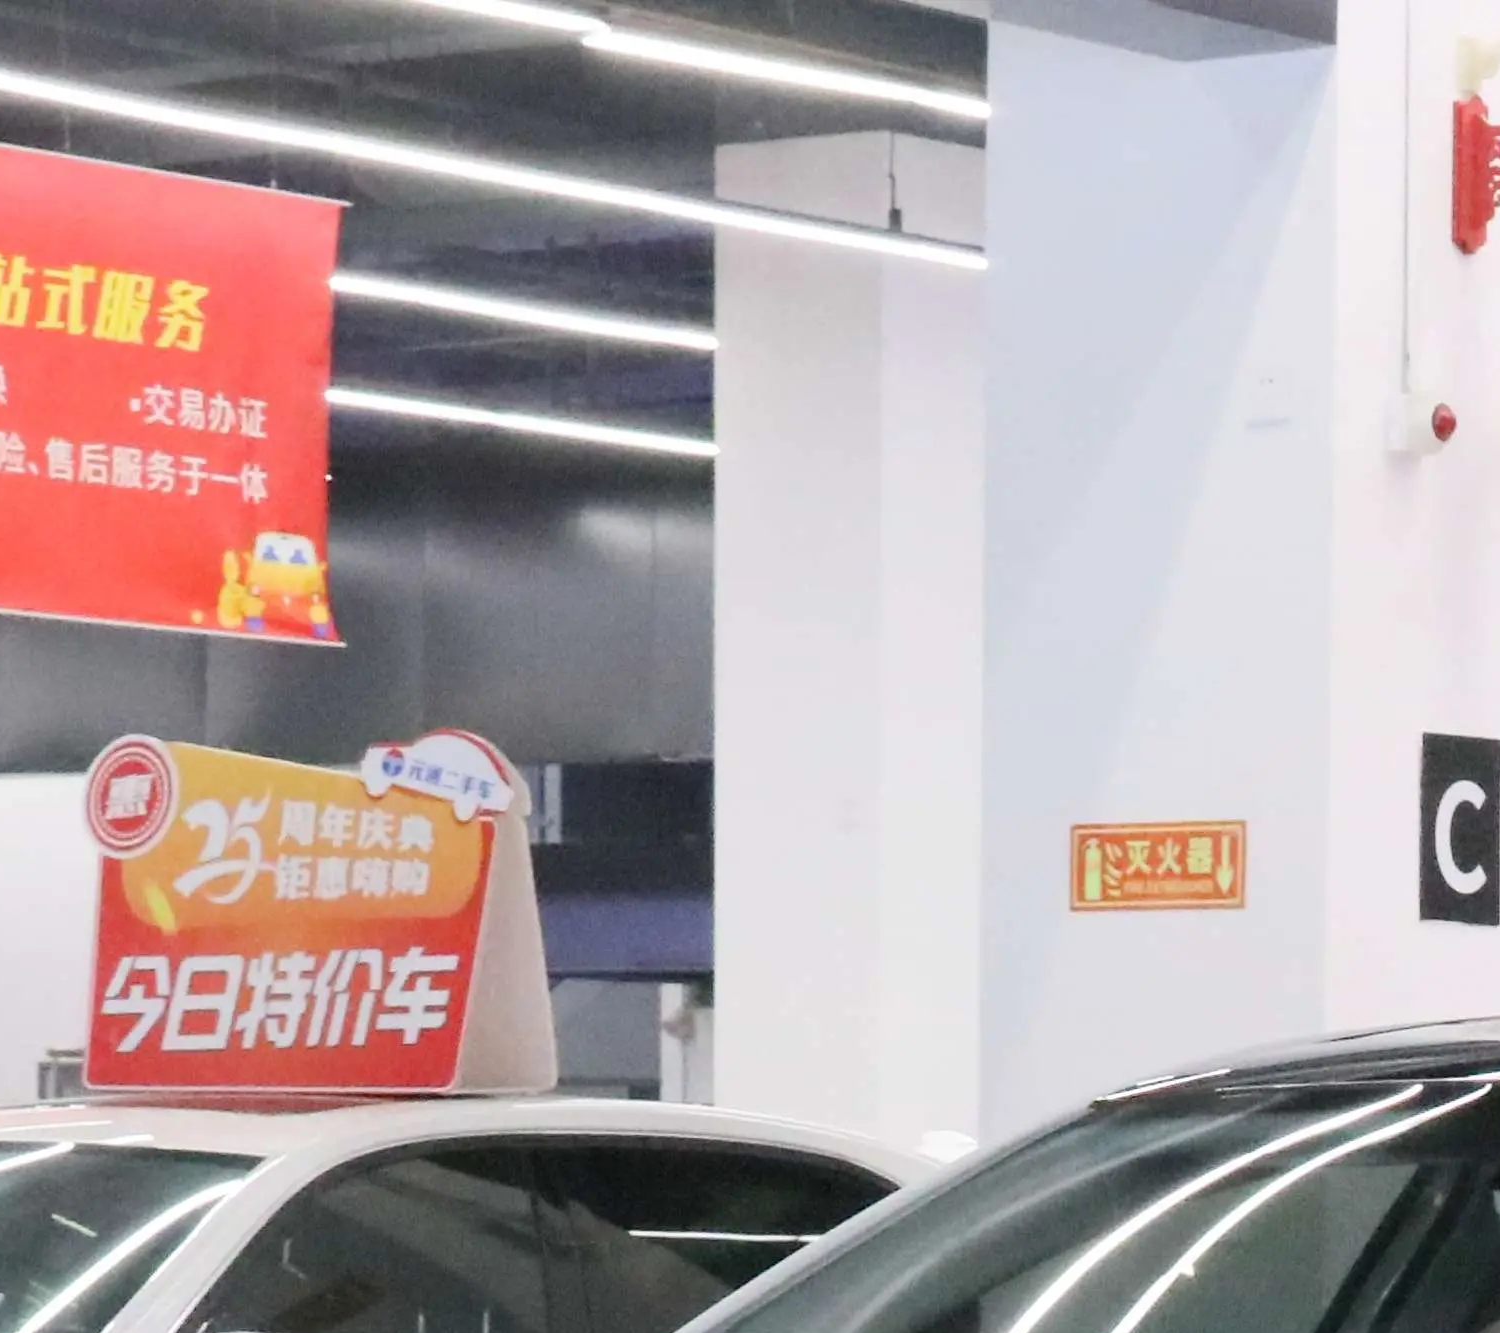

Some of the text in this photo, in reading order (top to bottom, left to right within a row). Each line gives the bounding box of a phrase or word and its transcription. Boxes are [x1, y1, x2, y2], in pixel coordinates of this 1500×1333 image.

[144, 384, 268, 439] 交易办证
[173, 786, 274, 904] 25
[278, 799, 434, 853] 周年庆典
[1126, 836, 1214, 876] 灭火器
[1435, 780, 1487, 894] C
[102, 947, 459, 1053] 今日特价车
